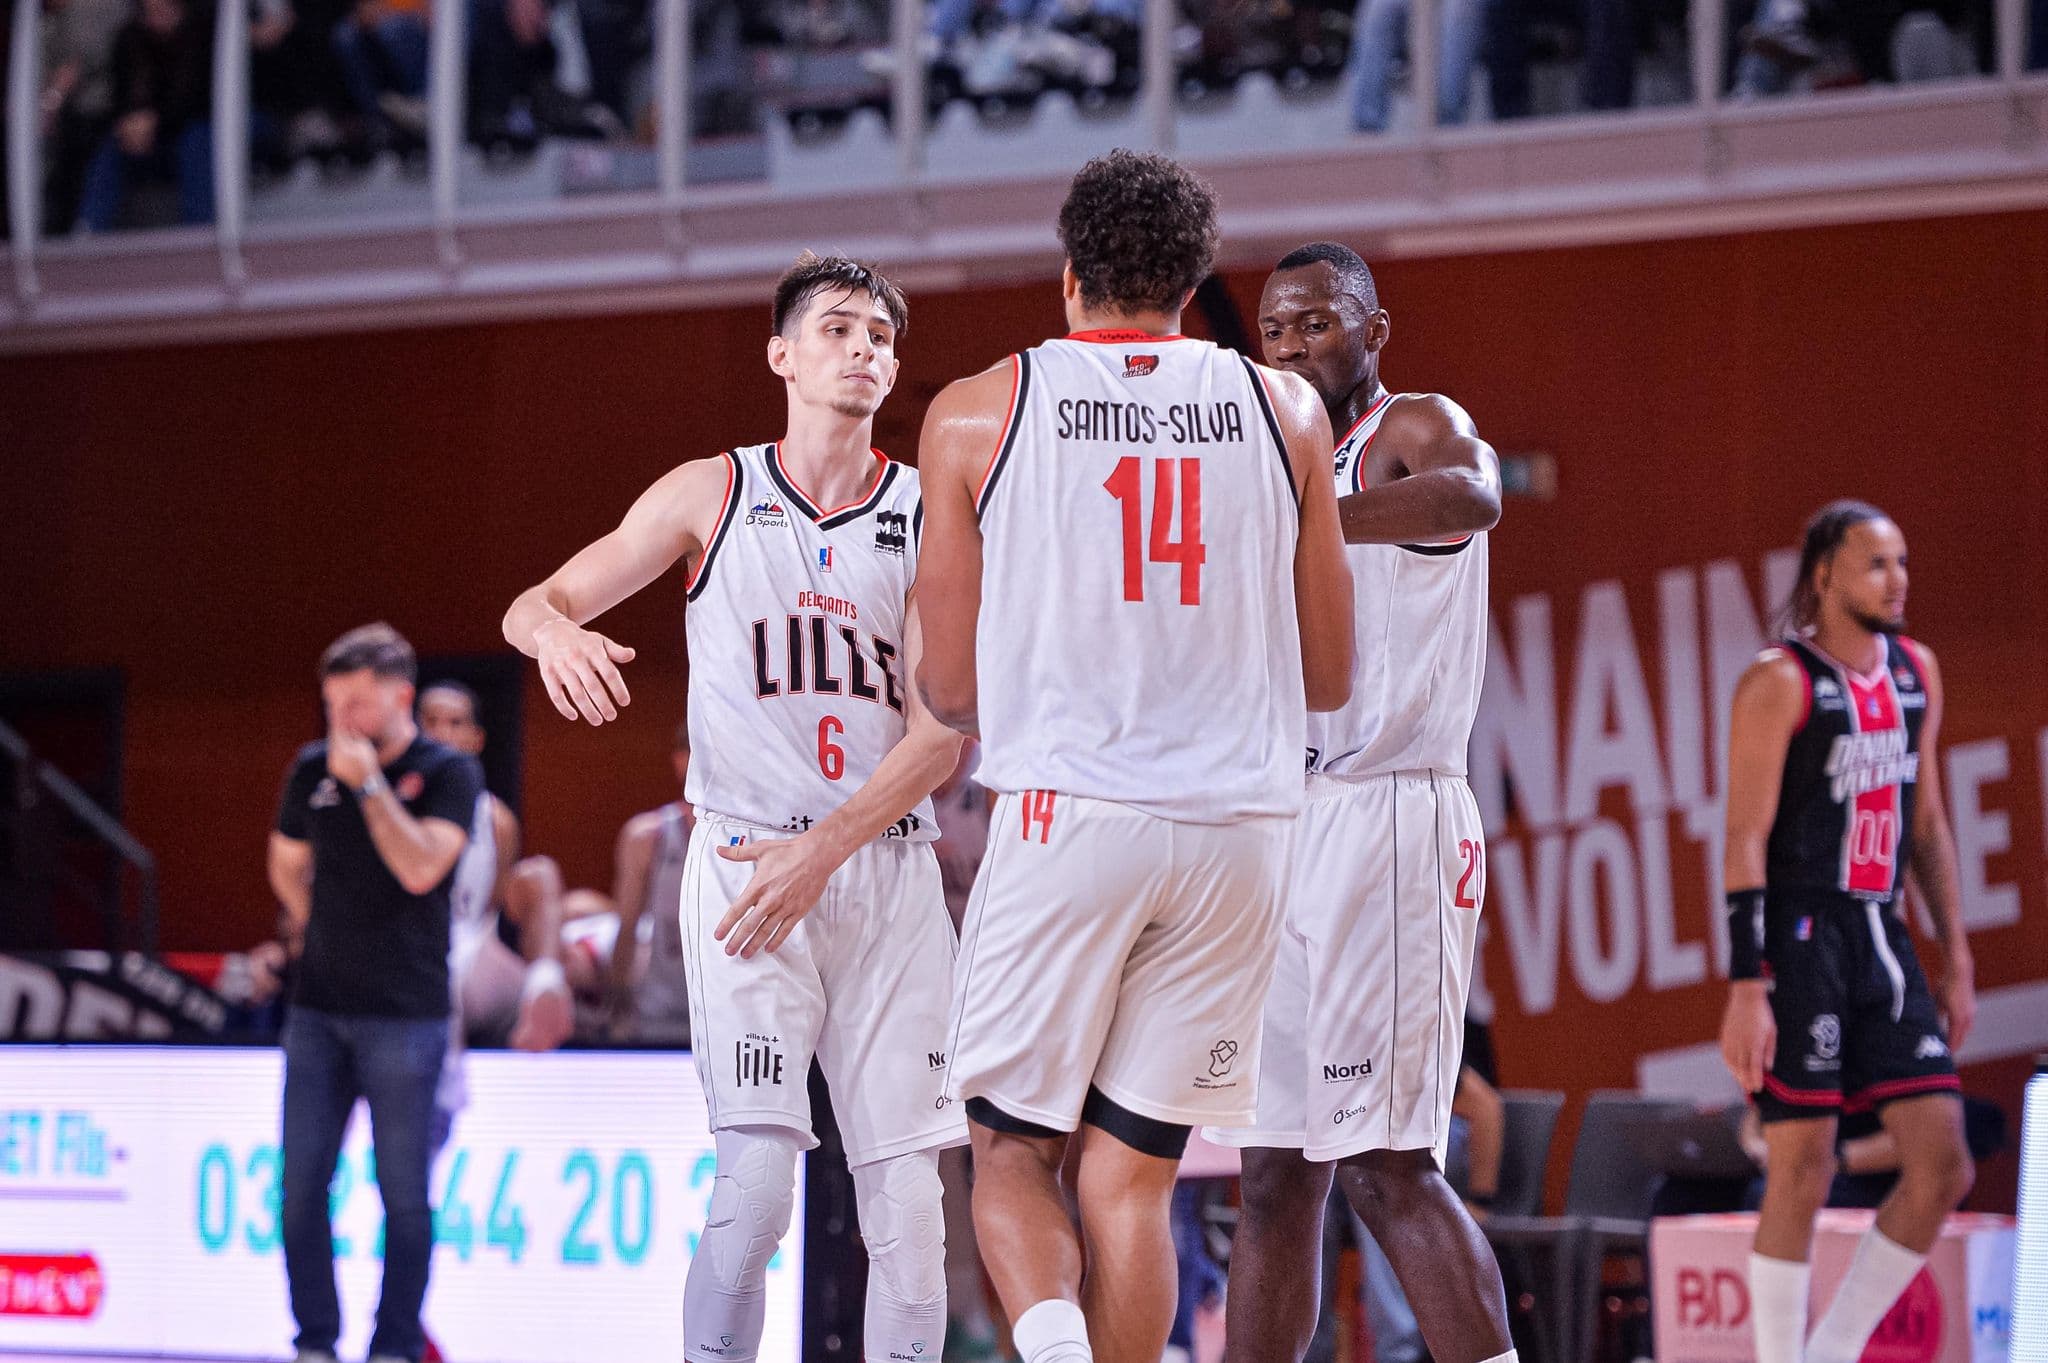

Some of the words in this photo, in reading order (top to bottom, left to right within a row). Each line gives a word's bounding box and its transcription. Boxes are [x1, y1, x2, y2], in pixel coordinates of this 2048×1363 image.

[1058, 398, 1245, 444] SANTOS-SILVA
[757, 516, 788, 528] Sports
[1103, 456, 1206, 605] 14
[817, 594, 857, 620] GIANTS
[751, 614, 903, 718] LILLE
[817, 714, 845, 781] 6
[1022, 788, 1057, 845] 14
[1853, 809, 1896, 866] 00
[1454, 838, 1482, 908] 20
[1323, 1058, 1372, 1080] Nord
[196, 1143, 284, 1255] 03
[560, 1148, 654, 1267] 20
